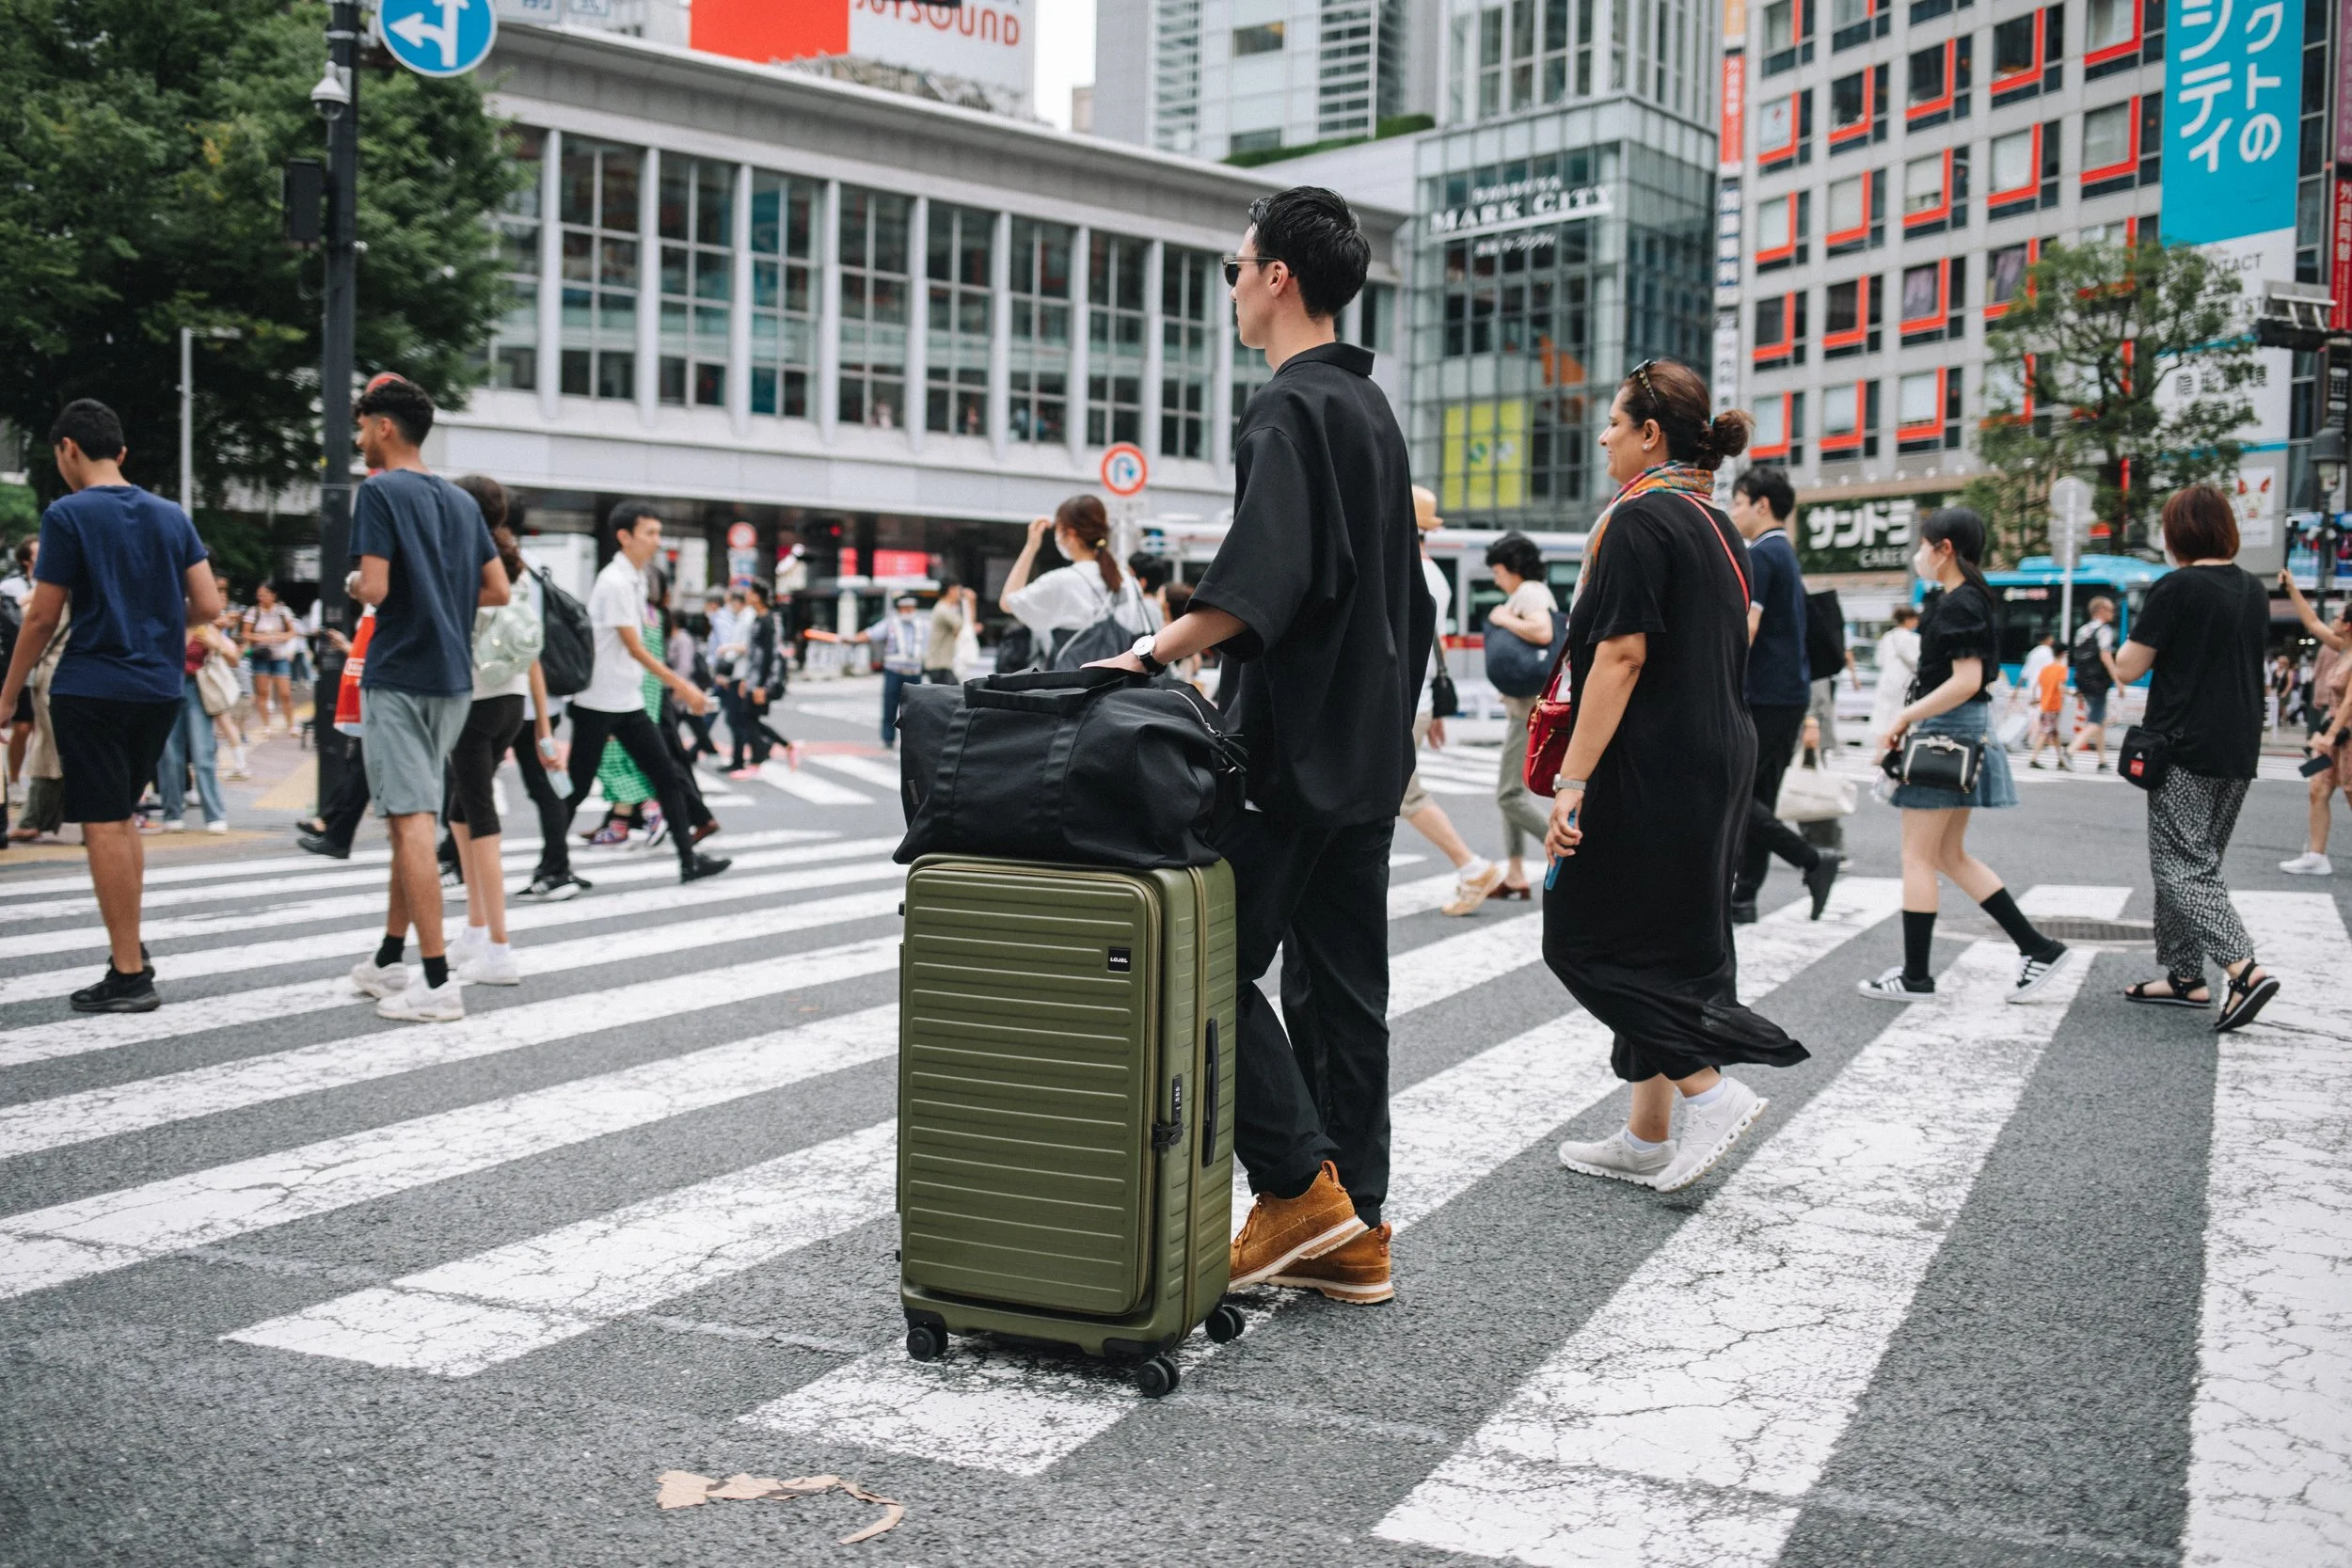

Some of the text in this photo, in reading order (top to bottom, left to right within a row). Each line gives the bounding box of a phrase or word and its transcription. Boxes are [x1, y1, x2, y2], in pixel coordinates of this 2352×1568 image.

[2239, 1, 2284, 164] クトの
[1429, 185, 1612, 235] MARK CITY
